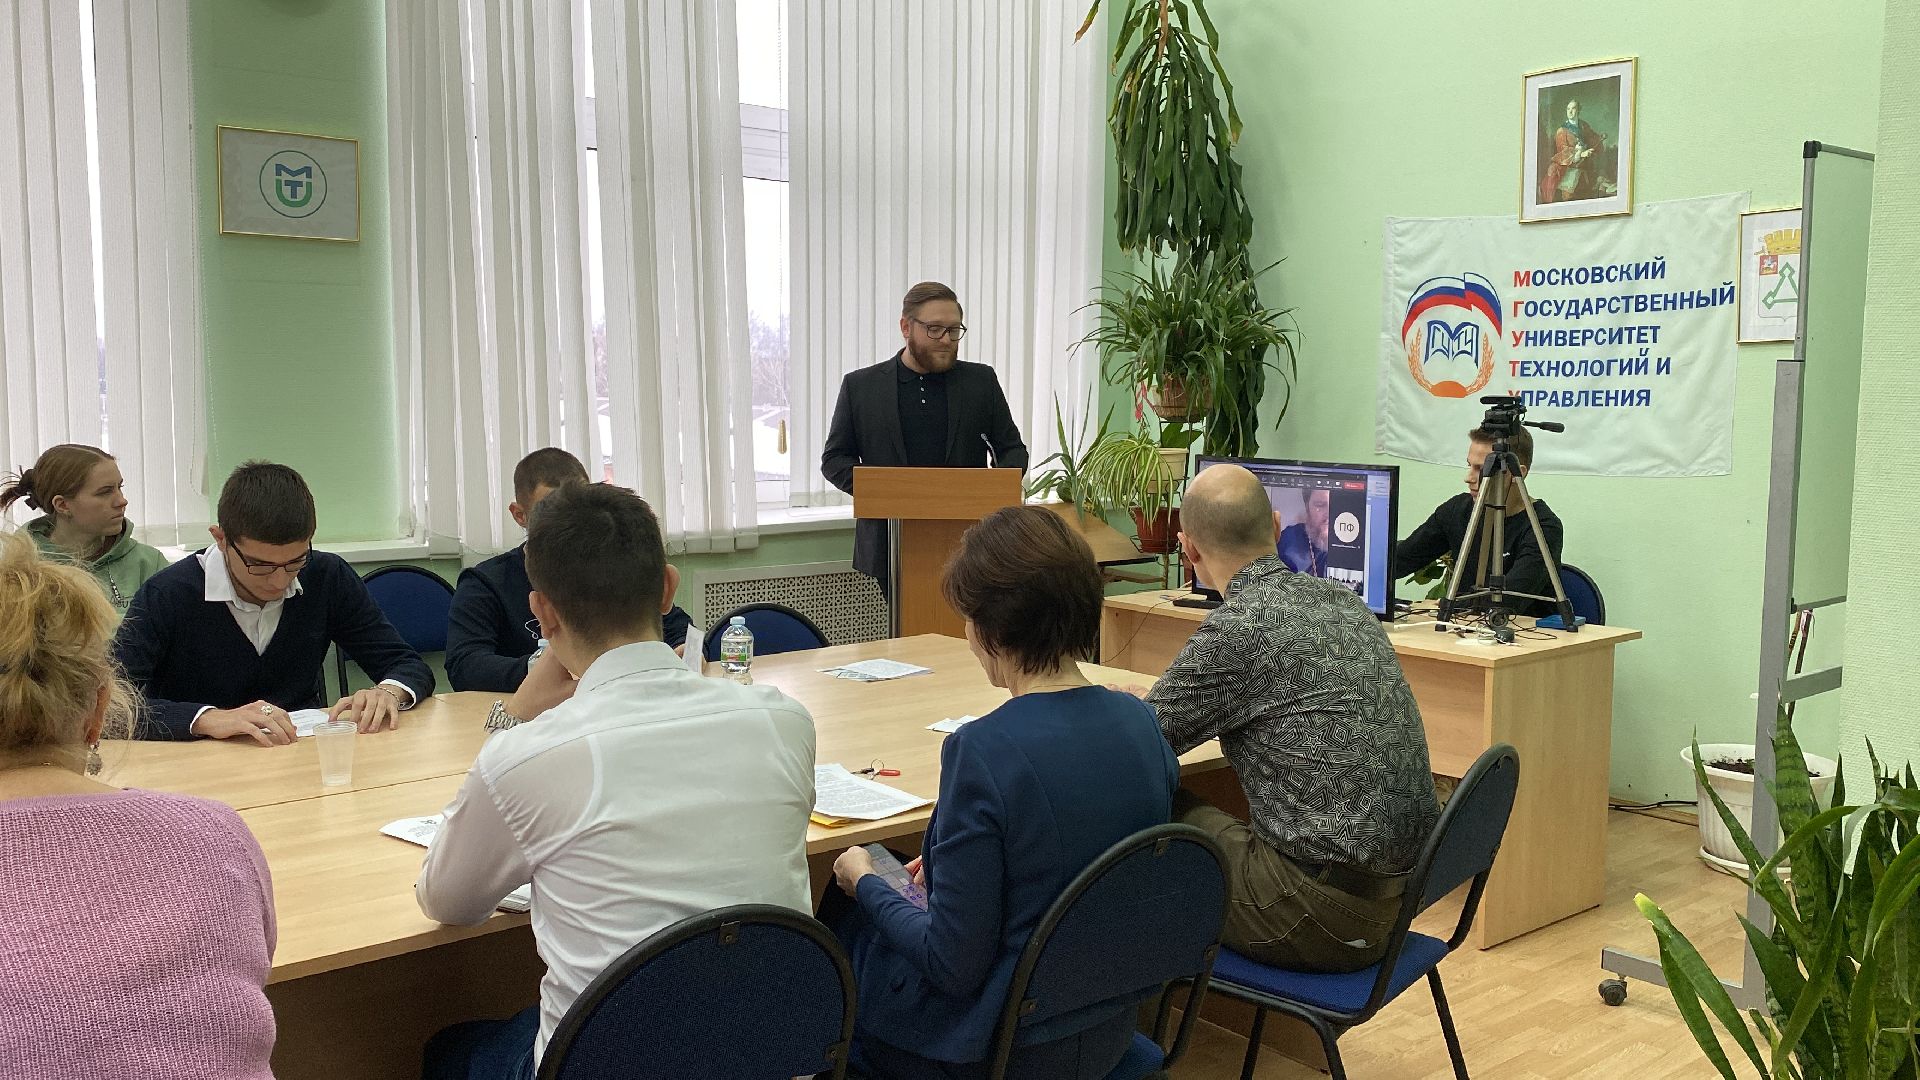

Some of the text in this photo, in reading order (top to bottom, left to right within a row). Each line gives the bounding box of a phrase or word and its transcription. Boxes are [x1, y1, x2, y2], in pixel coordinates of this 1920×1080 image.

[1513, 256, 1666, 287] МОСКОВСКИЙ
[1513, 281, 1735, 319] ГОСУДАРСТВЕННЫЙ
[1512, 325, 1661, 347] УНИВЕРСИТЕТ
[1508, 348, 1671, 378] ТЕХНОЛОГИЙ И
[1339, 522, 1355, 533] ПФ
